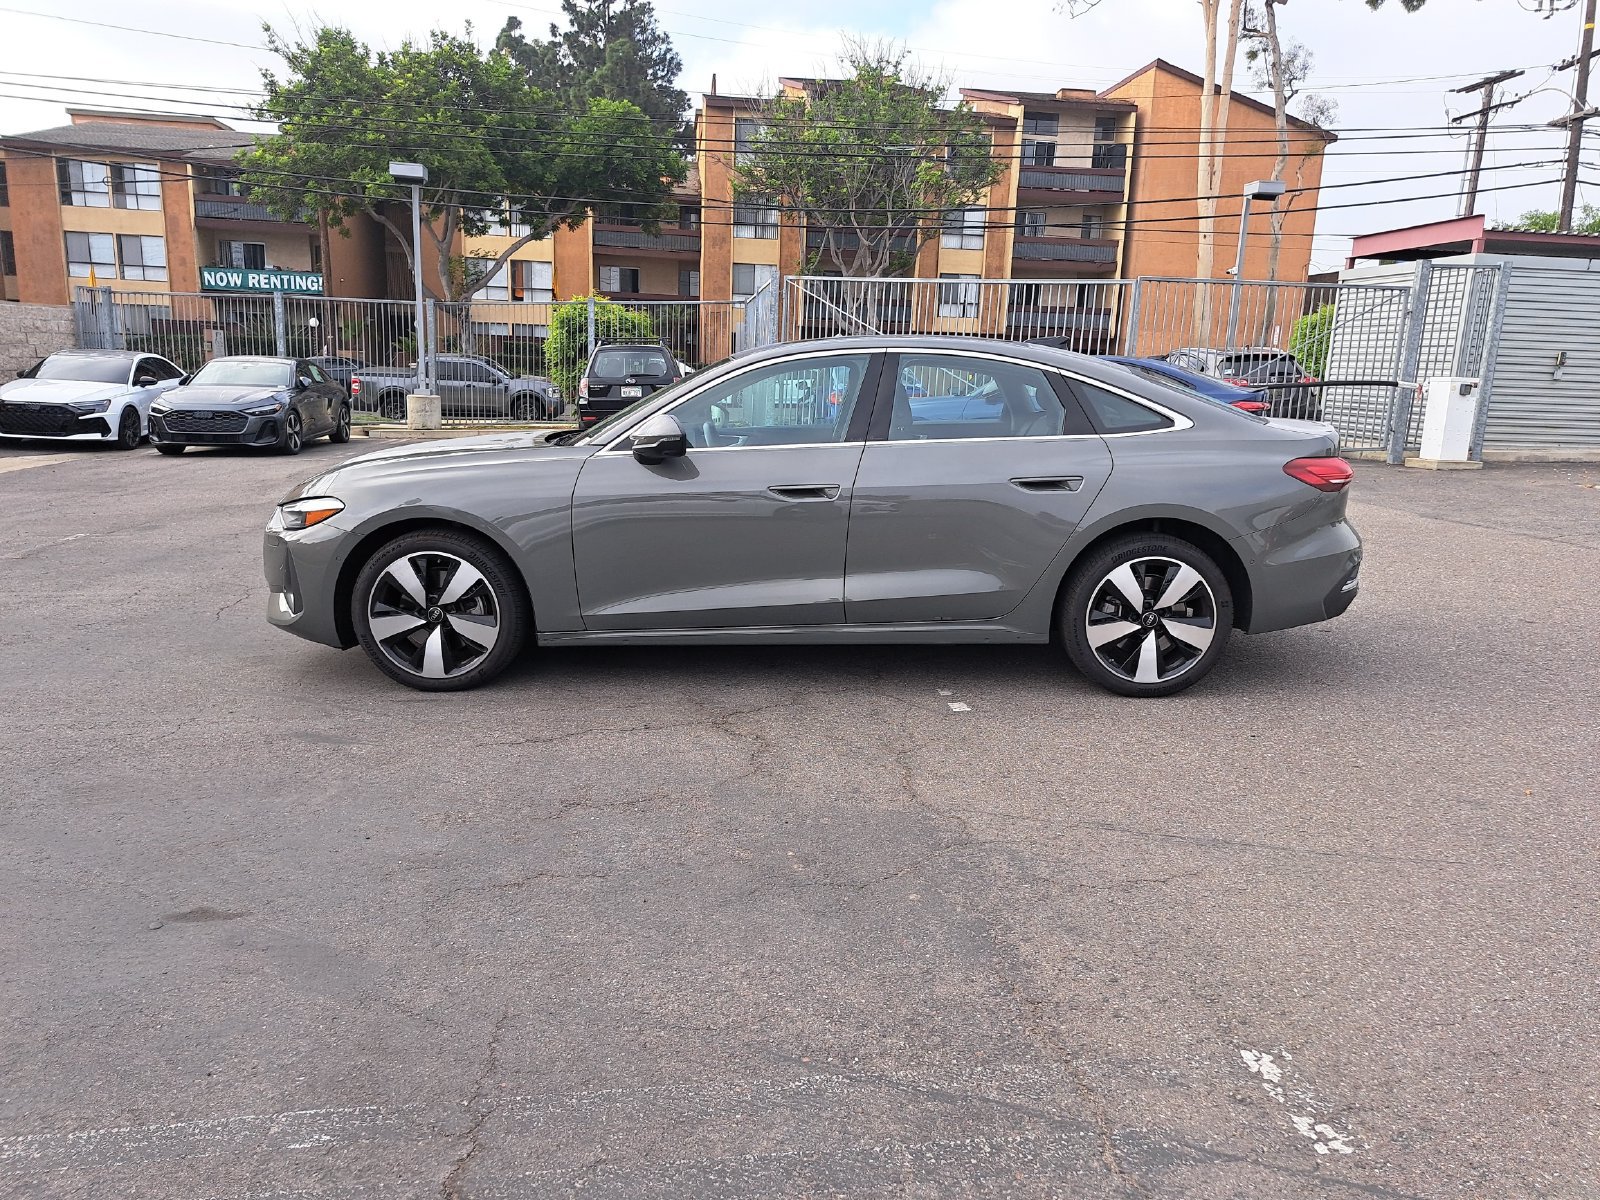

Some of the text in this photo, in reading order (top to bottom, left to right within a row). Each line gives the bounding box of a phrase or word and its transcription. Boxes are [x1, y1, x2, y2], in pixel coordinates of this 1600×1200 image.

[203, 271, 323, 291] NOW RENTING!
[1111, 544, 1168, 564] BRIDGESTONE
[468, 551, 507, 598] BRIDGESTONE
